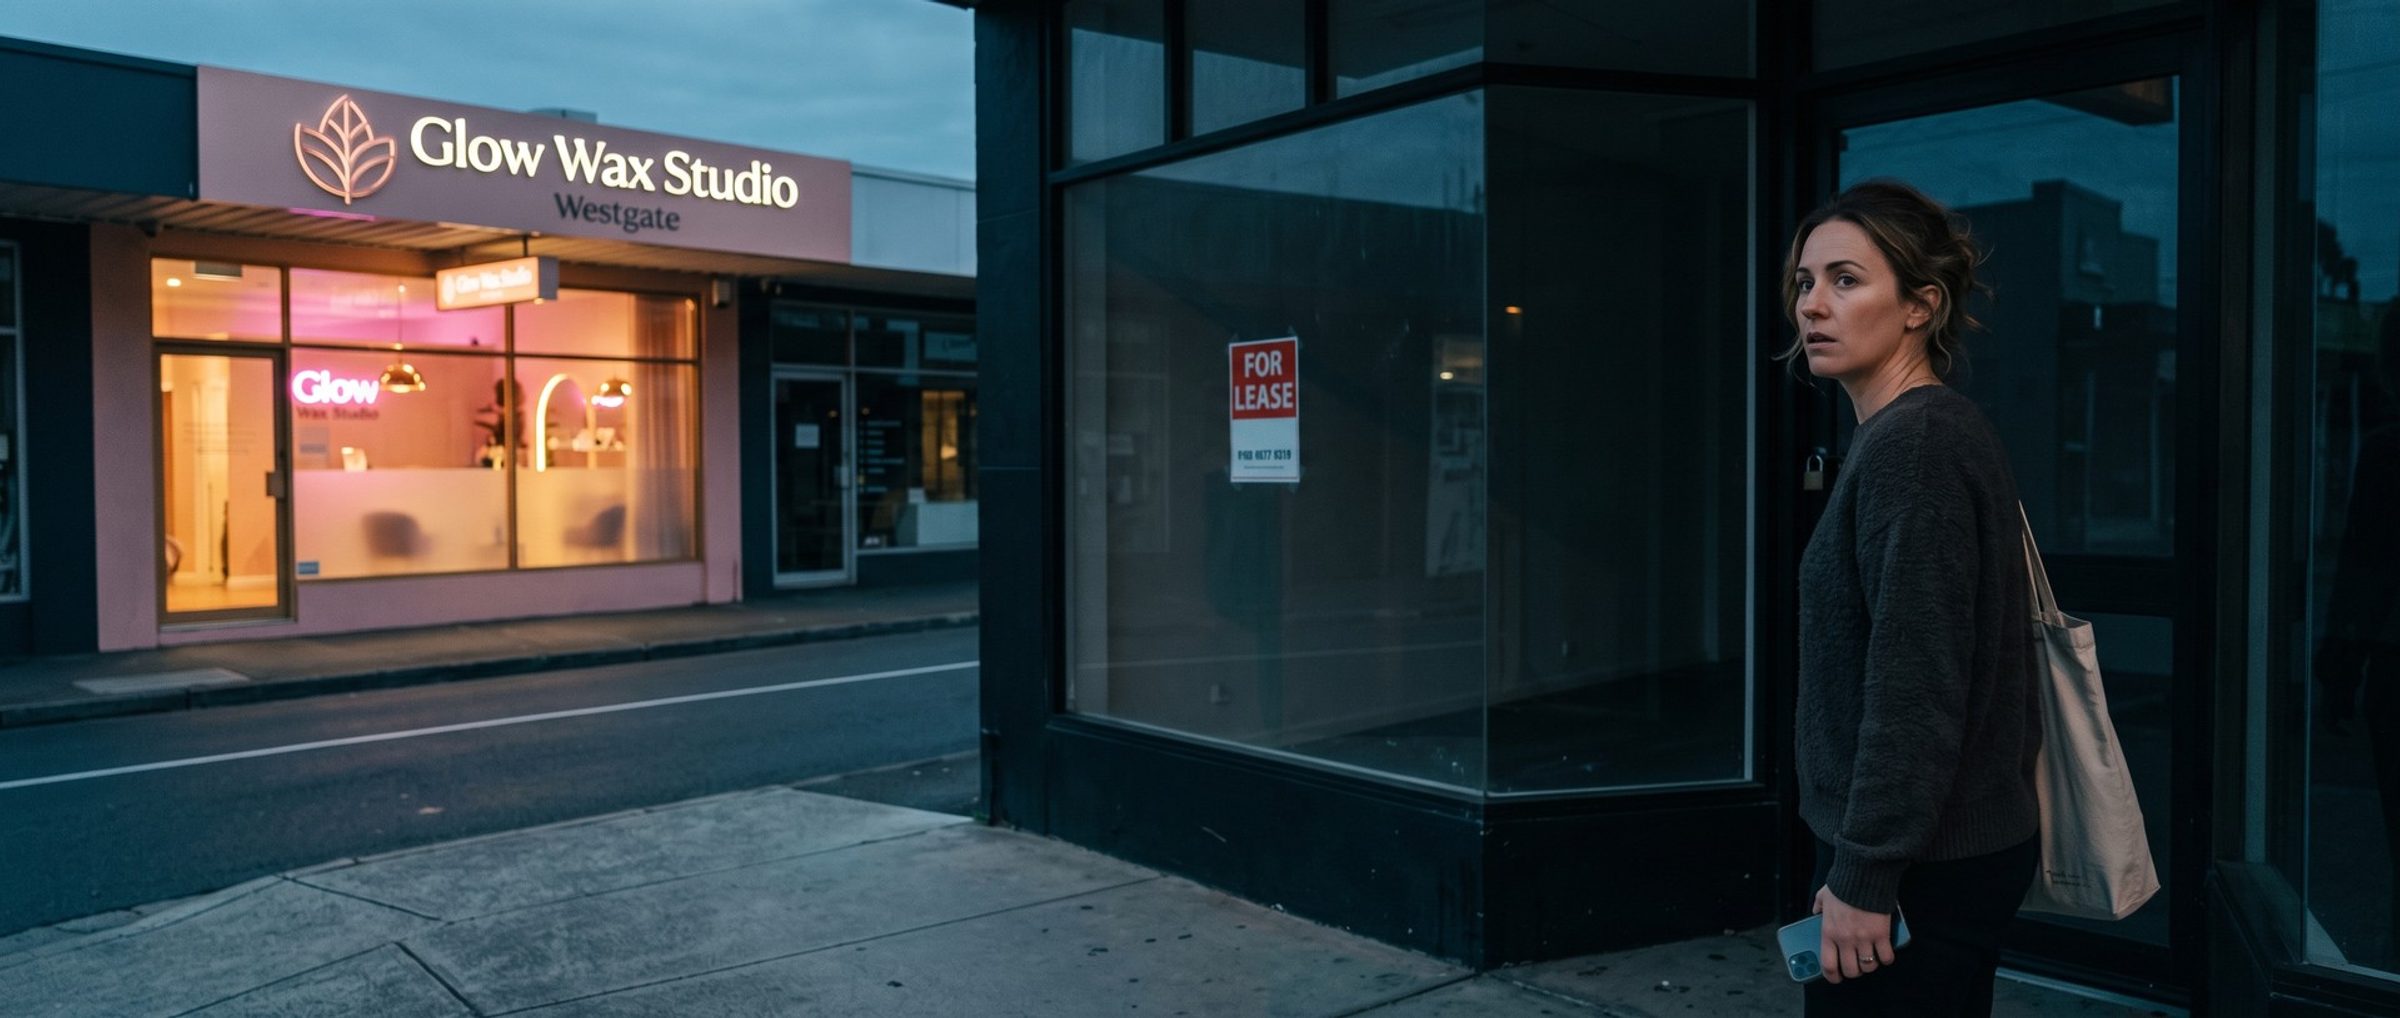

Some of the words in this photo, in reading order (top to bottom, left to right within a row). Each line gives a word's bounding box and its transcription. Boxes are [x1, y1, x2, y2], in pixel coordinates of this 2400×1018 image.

[410, 115, 545, 178] Glow
[553, 134, 656, 192] Wax
[664, 150, 799, 209] Studio
[554, 193, 681, 234] Westgate
[1244, 350, 1282, 378] FOR
[292, 369, 379, 404] Glow
[1234, 382, 1293, 411] LEASE
